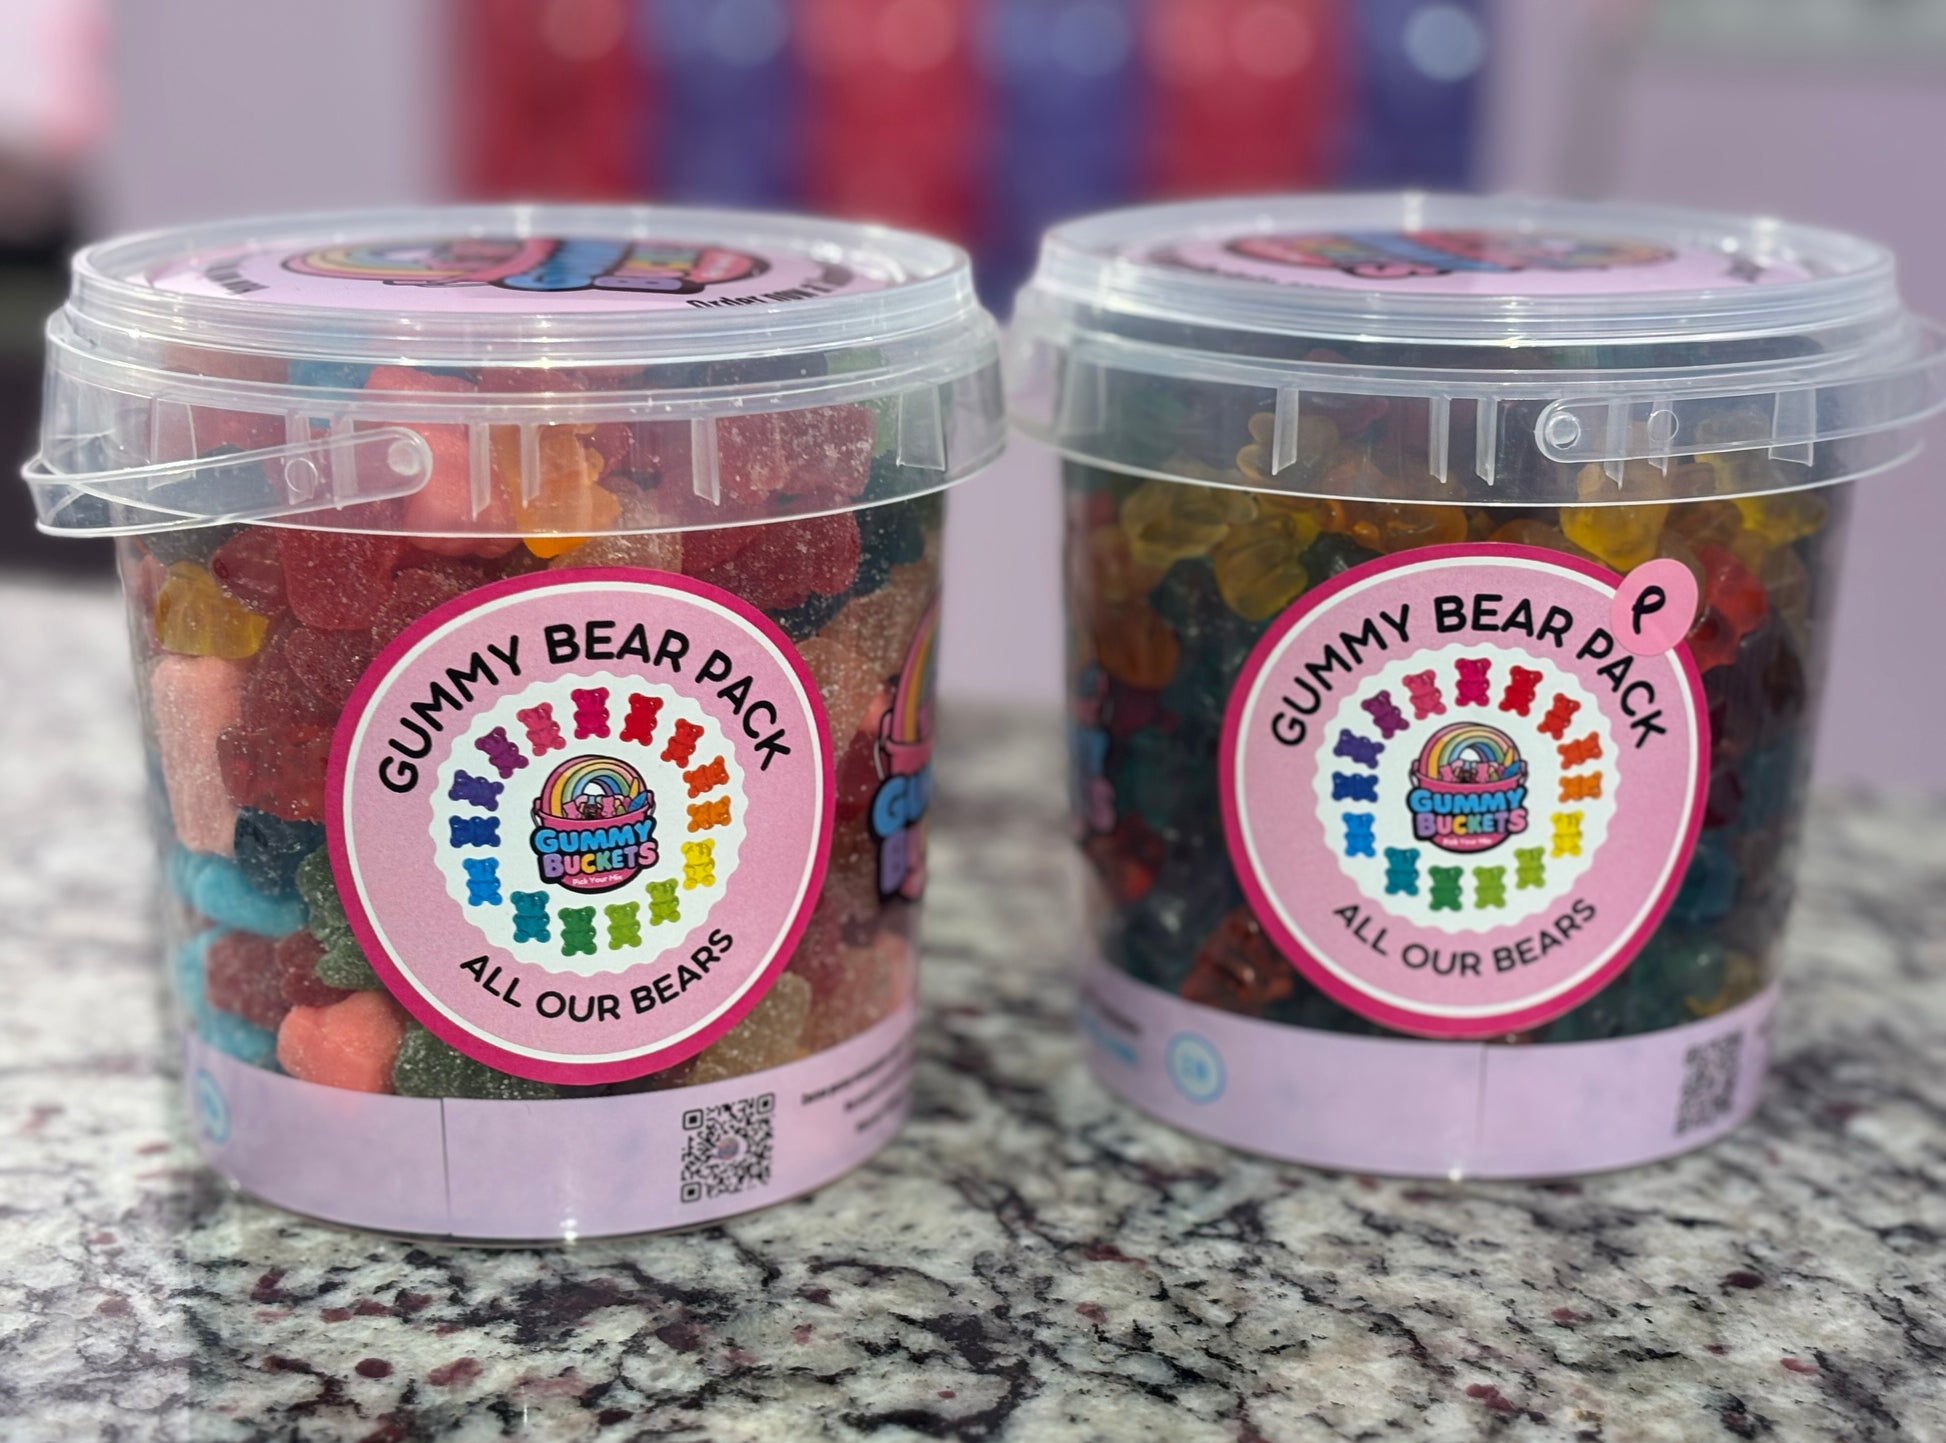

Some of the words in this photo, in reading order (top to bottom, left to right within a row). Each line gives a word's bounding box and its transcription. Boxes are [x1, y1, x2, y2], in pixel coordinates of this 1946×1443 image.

[1271, 603, 1410, 747] GUMMY
[1433, 593, 1574, 648] BEAR
[1575, 627, 1667, 749] PACK
[378, 634, 522, 794] GUMMY
[543, 620, 690, 673] BEAR
[694, 649, 791, 772] PACK
[1409, 786, 1526, 814] GUMMY
[1415, 808, 1527, 838] BUCKETS
[534, 819, 653, 854] GUMMY
[542, 841, 658, 879] BUCKETS
[1333, 904, 1388, 956] ALL
[1402, 943, 1482, 977] OUR
[1493, 899, 1596, 973] BEARS
[459, 955, 522, 1008] ALL
[535, 990, 621, 1023] OUR
[630, 928, 734, 1015] BEARS
